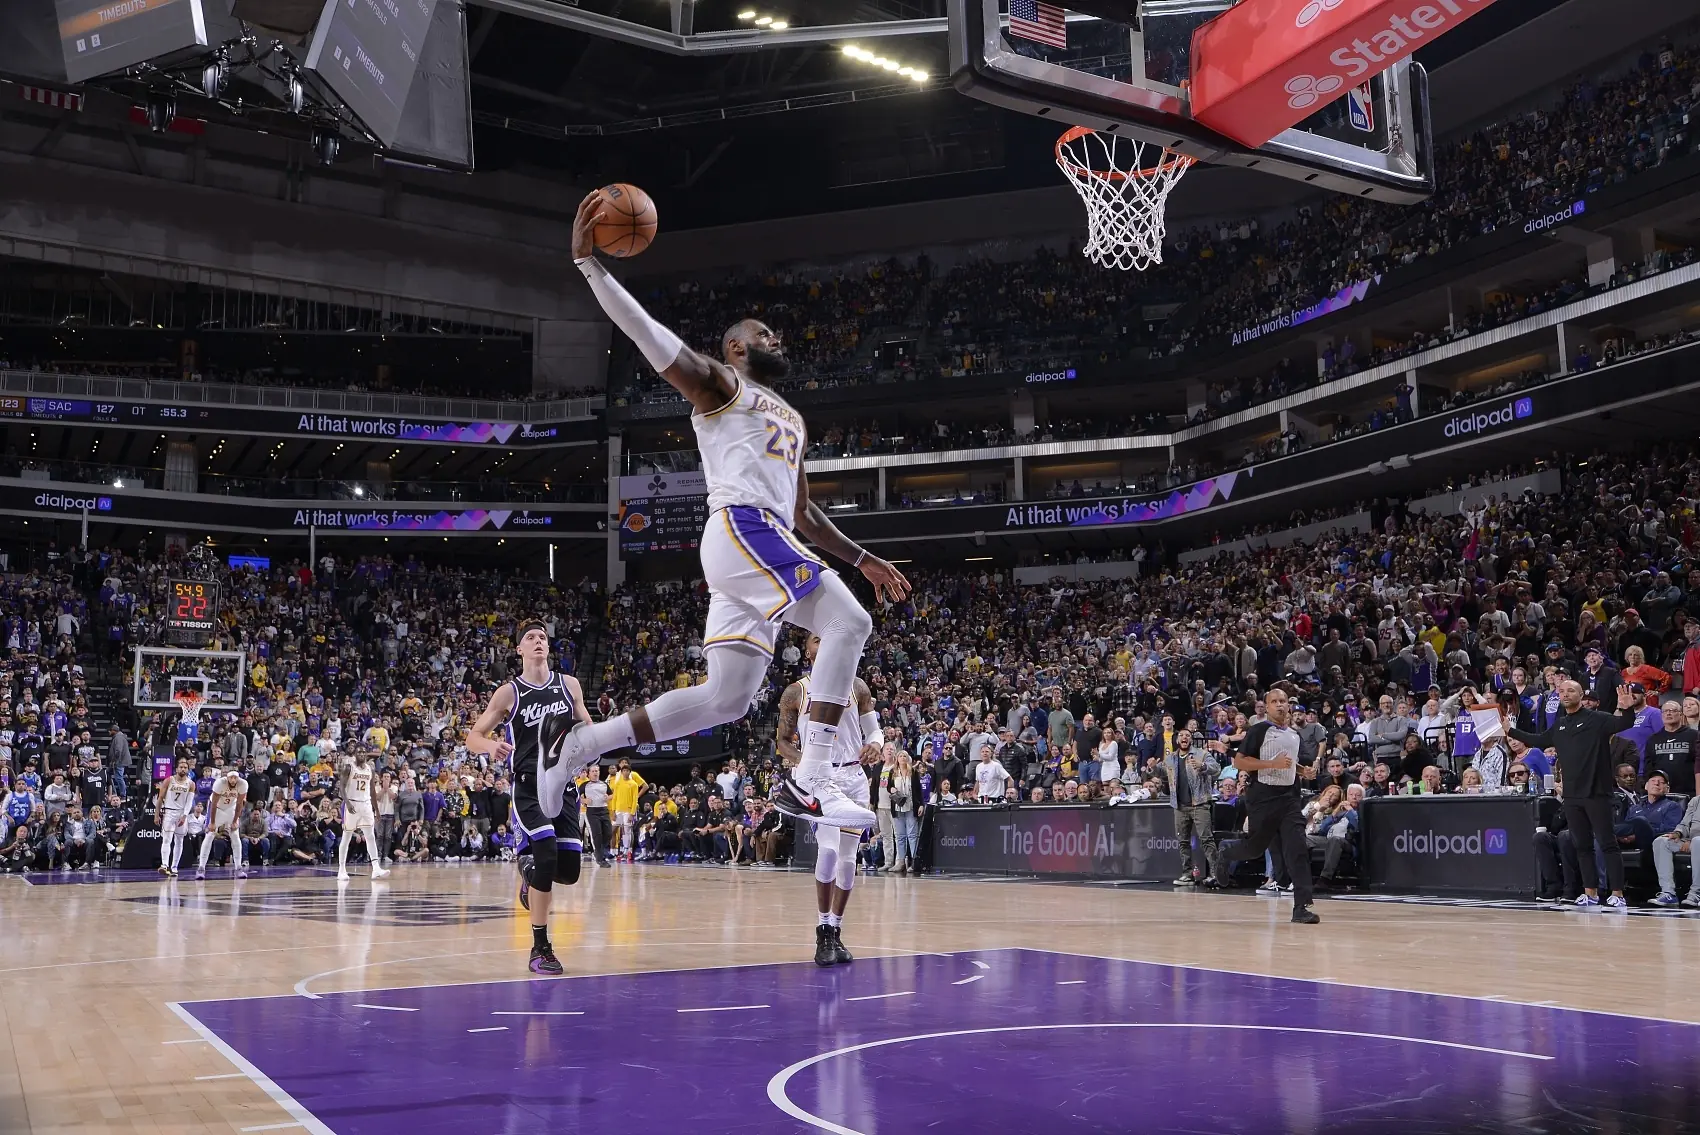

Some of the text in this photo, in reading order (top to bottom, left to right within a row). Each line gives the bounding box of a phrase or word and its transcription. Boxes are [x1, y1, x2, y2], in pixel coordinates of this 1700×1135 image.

[98, 0, 146, 21] TIMEOUTS
[356, 46, 384, 85] TIMEOUTS
[1353, 112, 1365, 126] NBA
[1524, 205, 1572, 233] dialpad
[1232, 331, 1241, 346] Ai
[1243, 325, 1261, 342] that
[1262, 315, 1290, 334] works
[1025, 370, 1066, 384] dialpad
[48, 401, 72, 411] SAC
[97, 404, 115, 414] 127
[160, 408, 187, 418] :55.3
[747, 392, 801, 433] LAKERS
[297, 415, 314, 430] Ai
[317, 416, 348, 432] that
[351, 419, 396, 435] works
[1444, 402, 1513, 437] dialpad
[520, 429, 550, 439] dialpad
[765, 418, 798, 470] 23
[35, 493, 96, 510] dialpad
[293, 509, 309, 525] Ai
[313, 509, 342, 525] that
[512, 515, 544, 525] dialpad
[1006, 506, 1024, 526] Ai
[1027, 505, 1062, 524] that
[176, 583, 203, 597] 54.9
[177, 596, 207, 618] 22
[182, 621, 213, 629] TISSOT
[520, 700, 569, 727] Kings
[1461, 723, 1472, 733] 13
[1654, 742, 1690, 750] KINGS
[356, 780, 366, 791] 12
[174, 792, 182, 801] 7
[13, 807, 26, 816] 23
[136, 828, 161, 840] dialp
[940, 834, 968, 848] dialpad
[1000, 823, 1115, 857] The Good Ai
[1146, 835, 1180, 853] dialpa
[1393, 829, 1482, 859] dialpad
